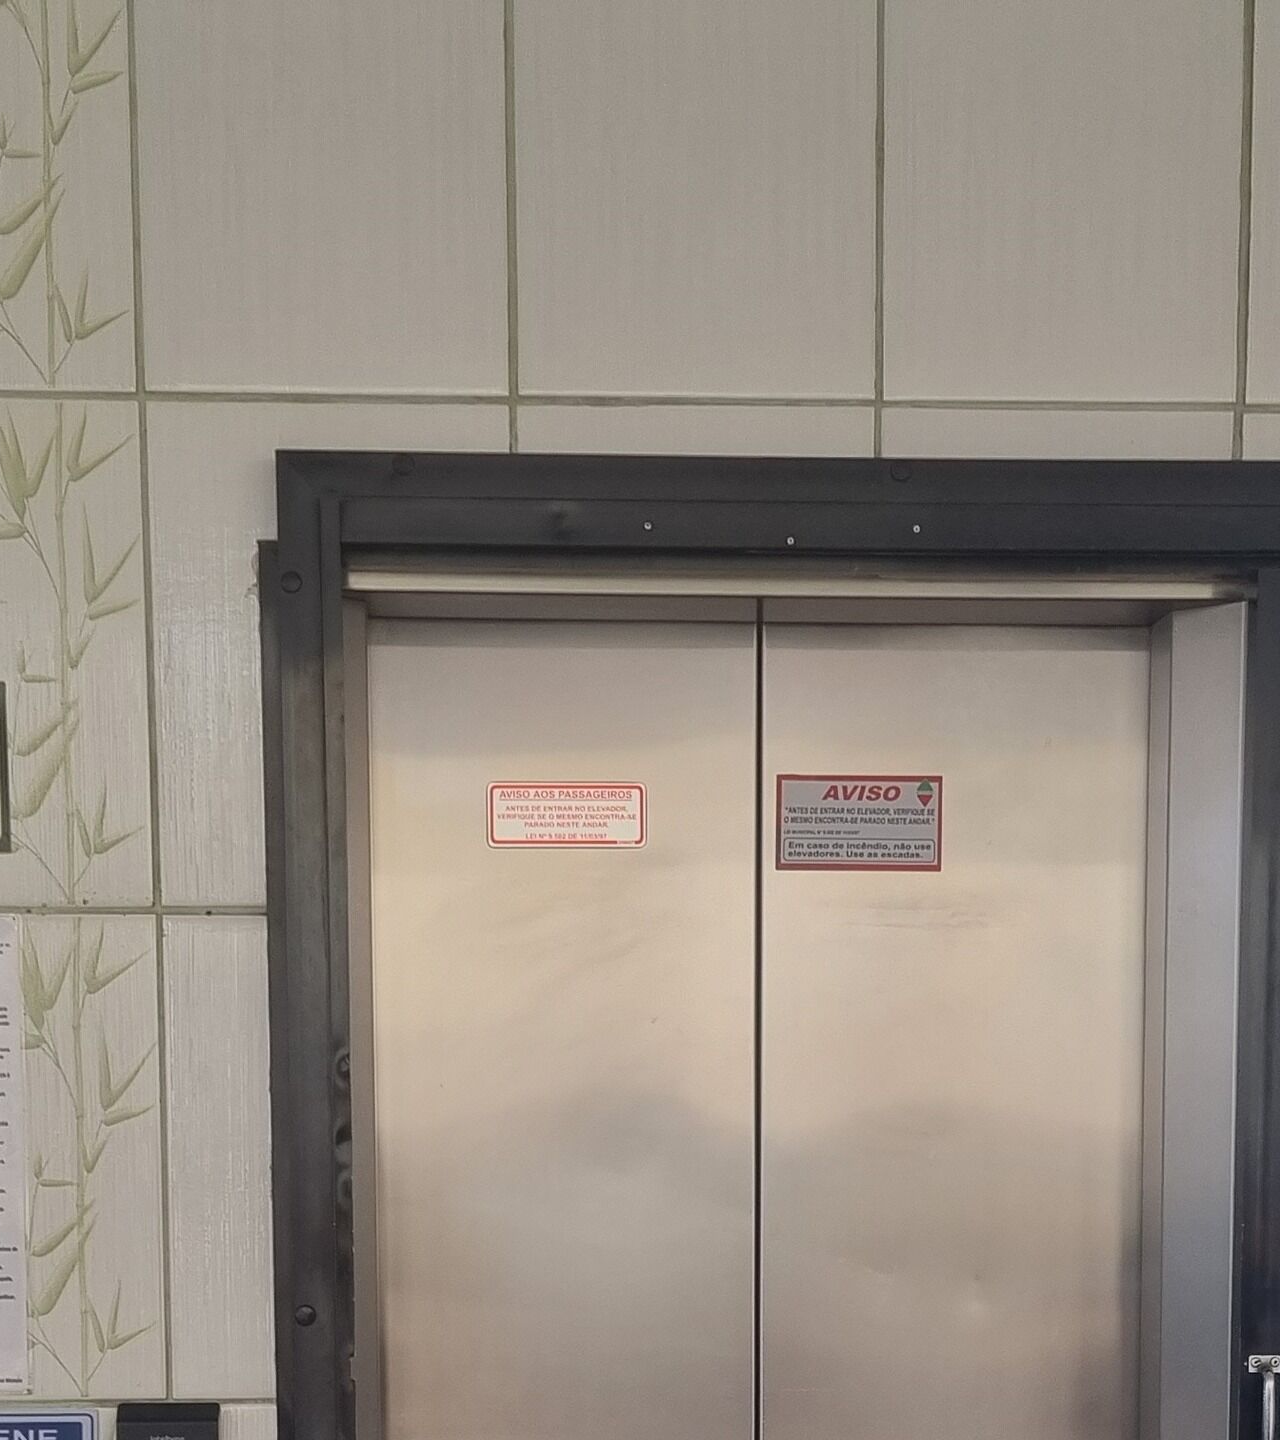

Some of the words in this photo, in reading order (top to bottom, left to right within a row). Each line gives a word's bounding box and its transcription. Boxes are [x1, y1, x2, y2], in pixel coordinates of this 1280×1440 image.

[500, 790, 529, 799] AVISO
[533, 790, 555, 799] AOS
[559, 790, 632, 799] PASSAGEIROS
[822, 785, 901, 801] AVISO
[832, 842, 844, 850] de
[847, 842, 891, 851] incêndio,
[894, 843, 911, 851] não
[788, 850, 843, 858] elevadores.
[881, 851, 923, 859] escadas.
